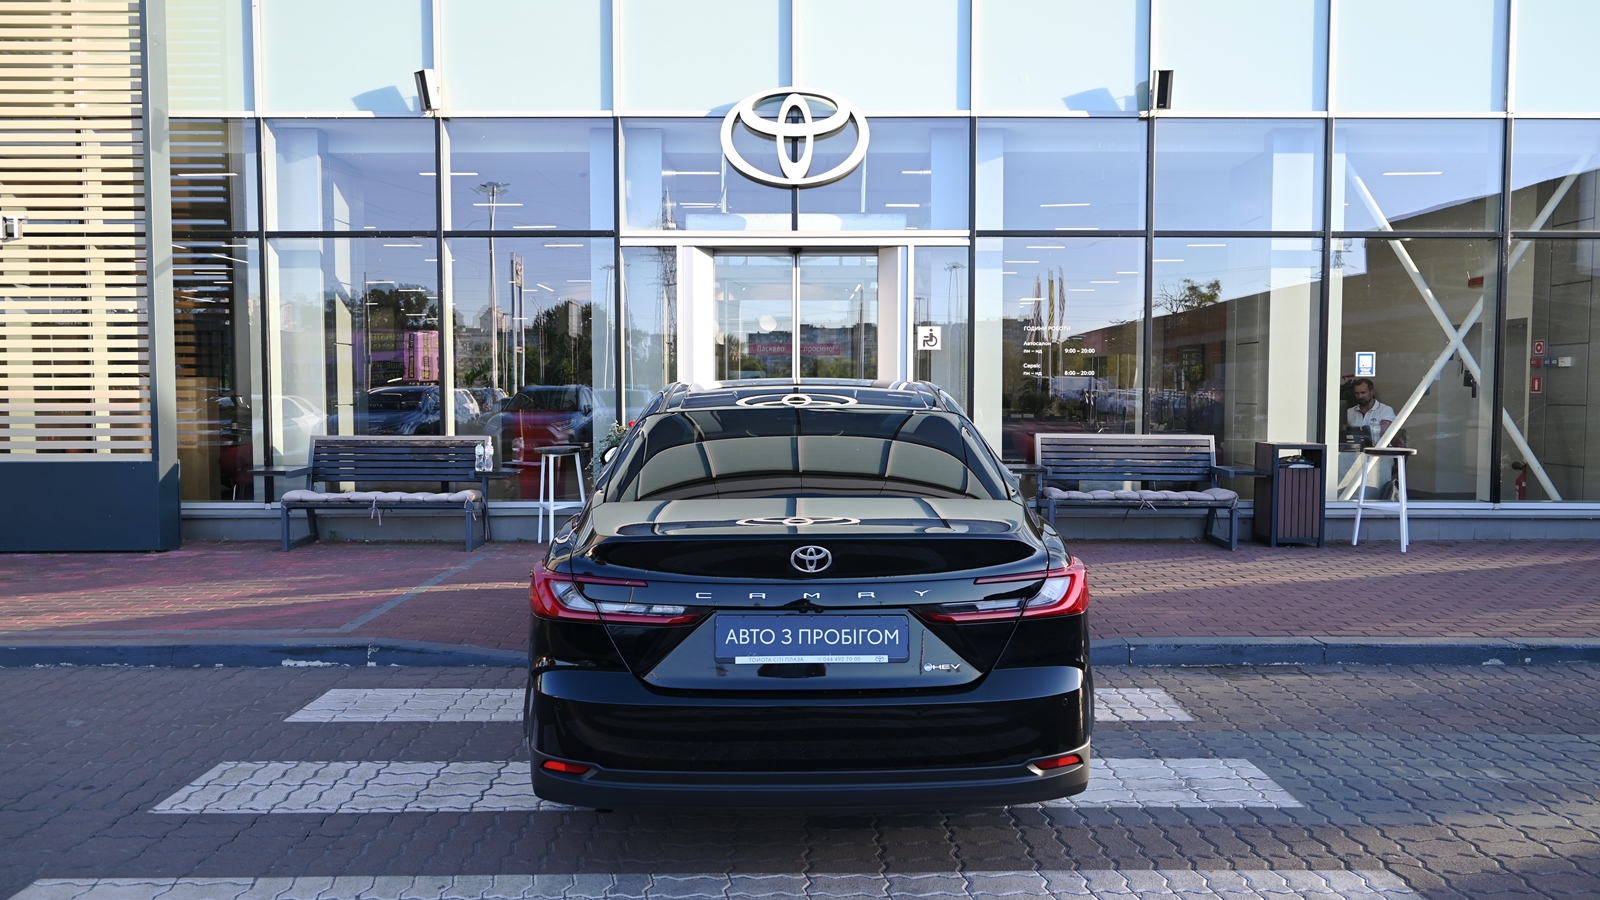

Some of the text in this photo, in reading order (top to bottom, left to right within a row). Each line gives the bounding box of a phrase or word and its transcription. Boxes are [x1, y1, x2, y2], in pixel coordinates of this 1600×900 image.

[756, 344, 835, 353] Ласкаво просимо!
[695, 589, 932, 600] CAMRY
[725, 628, 776, 645] АВТО
[799, 627, 899, 645] ПРОБІГОМ
[932, 663, 961, 671] HEV
